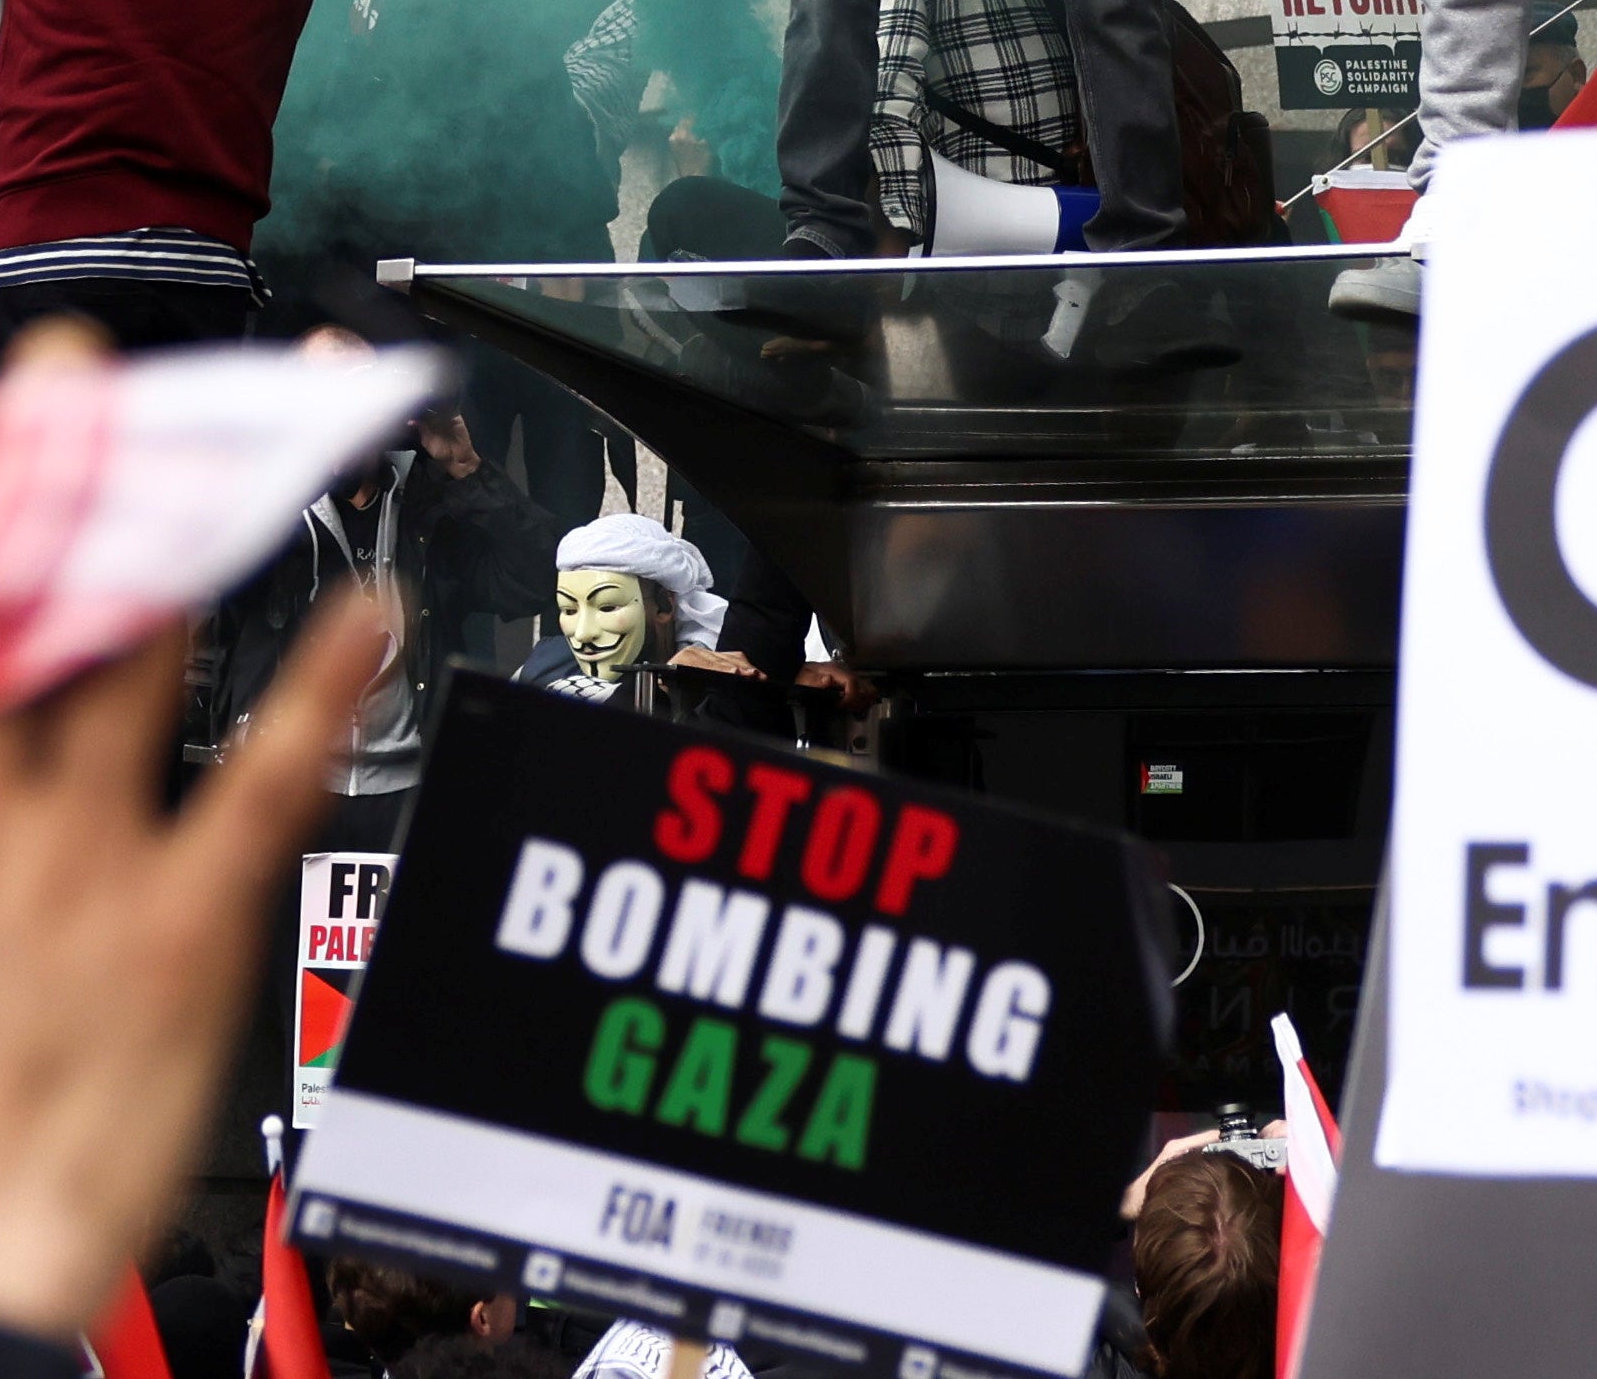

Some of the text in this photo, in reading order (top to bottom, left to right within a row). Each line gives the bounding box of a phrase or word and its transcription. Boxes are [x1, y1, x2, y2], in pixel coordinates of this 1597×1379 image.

[1345, 60, 1408, 70] PALESTINE
[1347, 71, 1415, 82] SOLIDARITY
[1348, 83, 1408, 94] CAMPAIGN
[654, 744, 959, 918] STOP
[328, 863, 390, 919] FR
[496, 837, 1051, 1083] BOMBING
[584, 996, 878, 1171] GAZA
[598, 1183, 678, 1251] FOA
